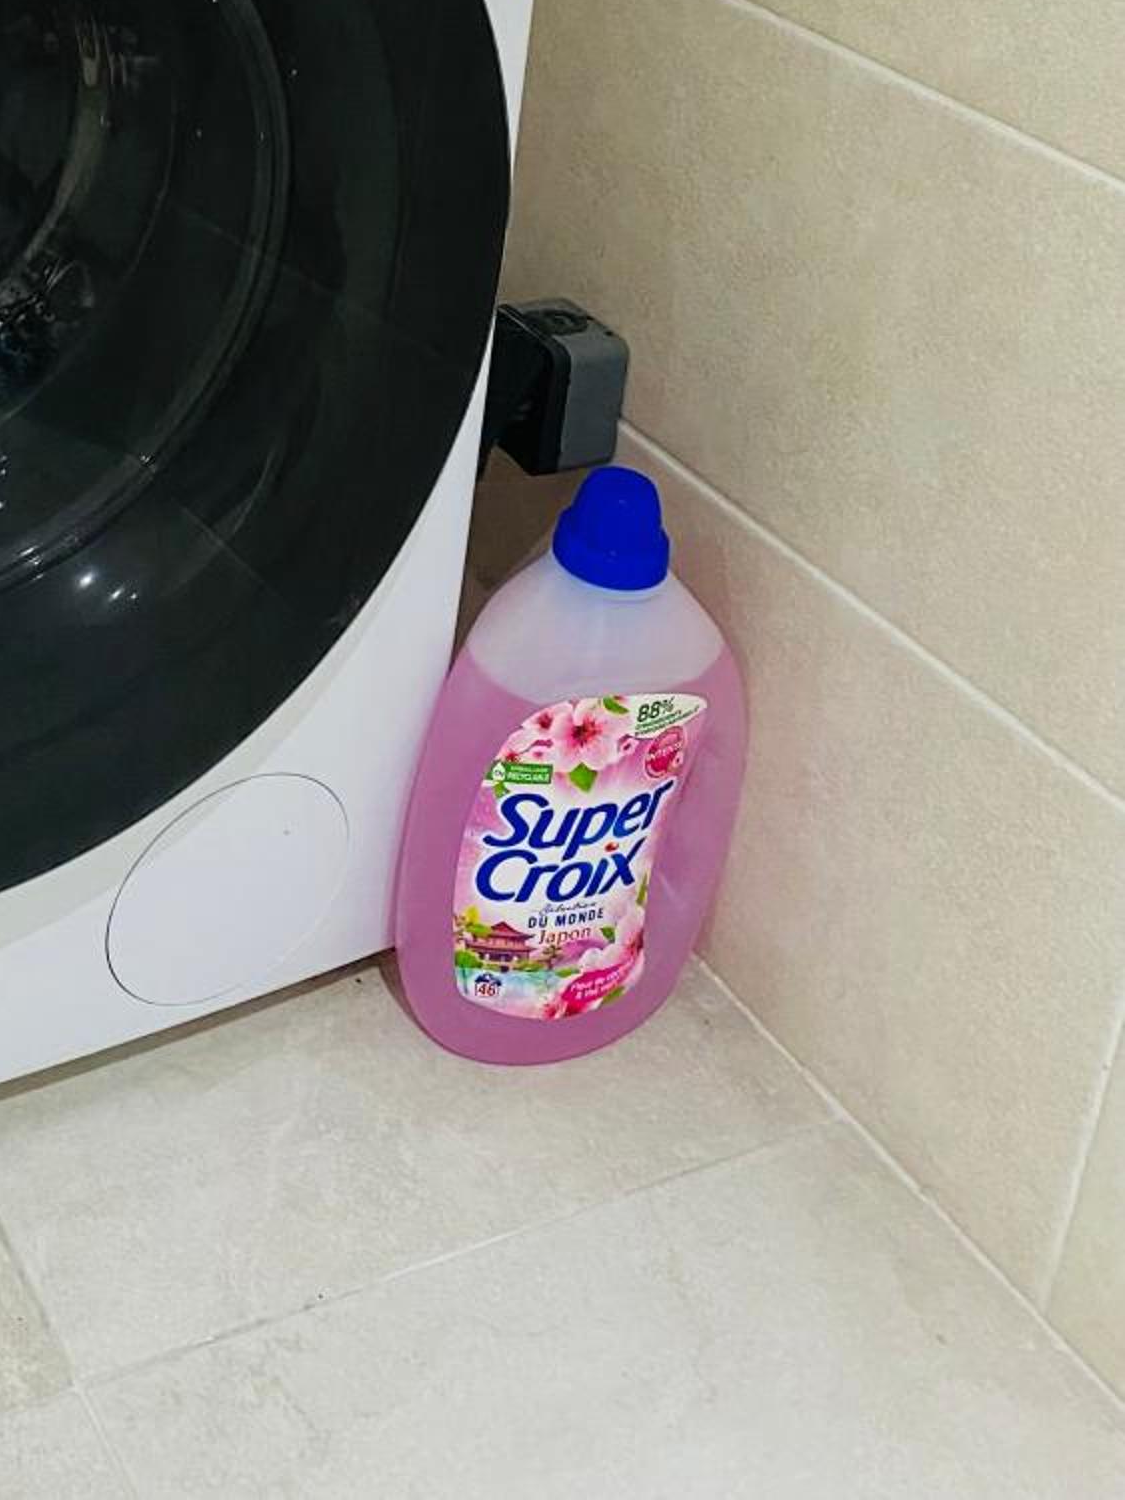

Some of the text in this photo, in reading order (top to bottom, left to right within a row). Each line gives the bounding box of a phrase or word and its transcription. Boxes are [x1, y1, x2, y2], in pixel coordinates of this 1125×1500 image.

[482, 779, 674, 862] Super
[476, 836, 647, 903] Croix
[528, 907, 604, 929] DU MONDE
[538, 927, 591, 946] Japon
[478, 983, 496, 997] 46
